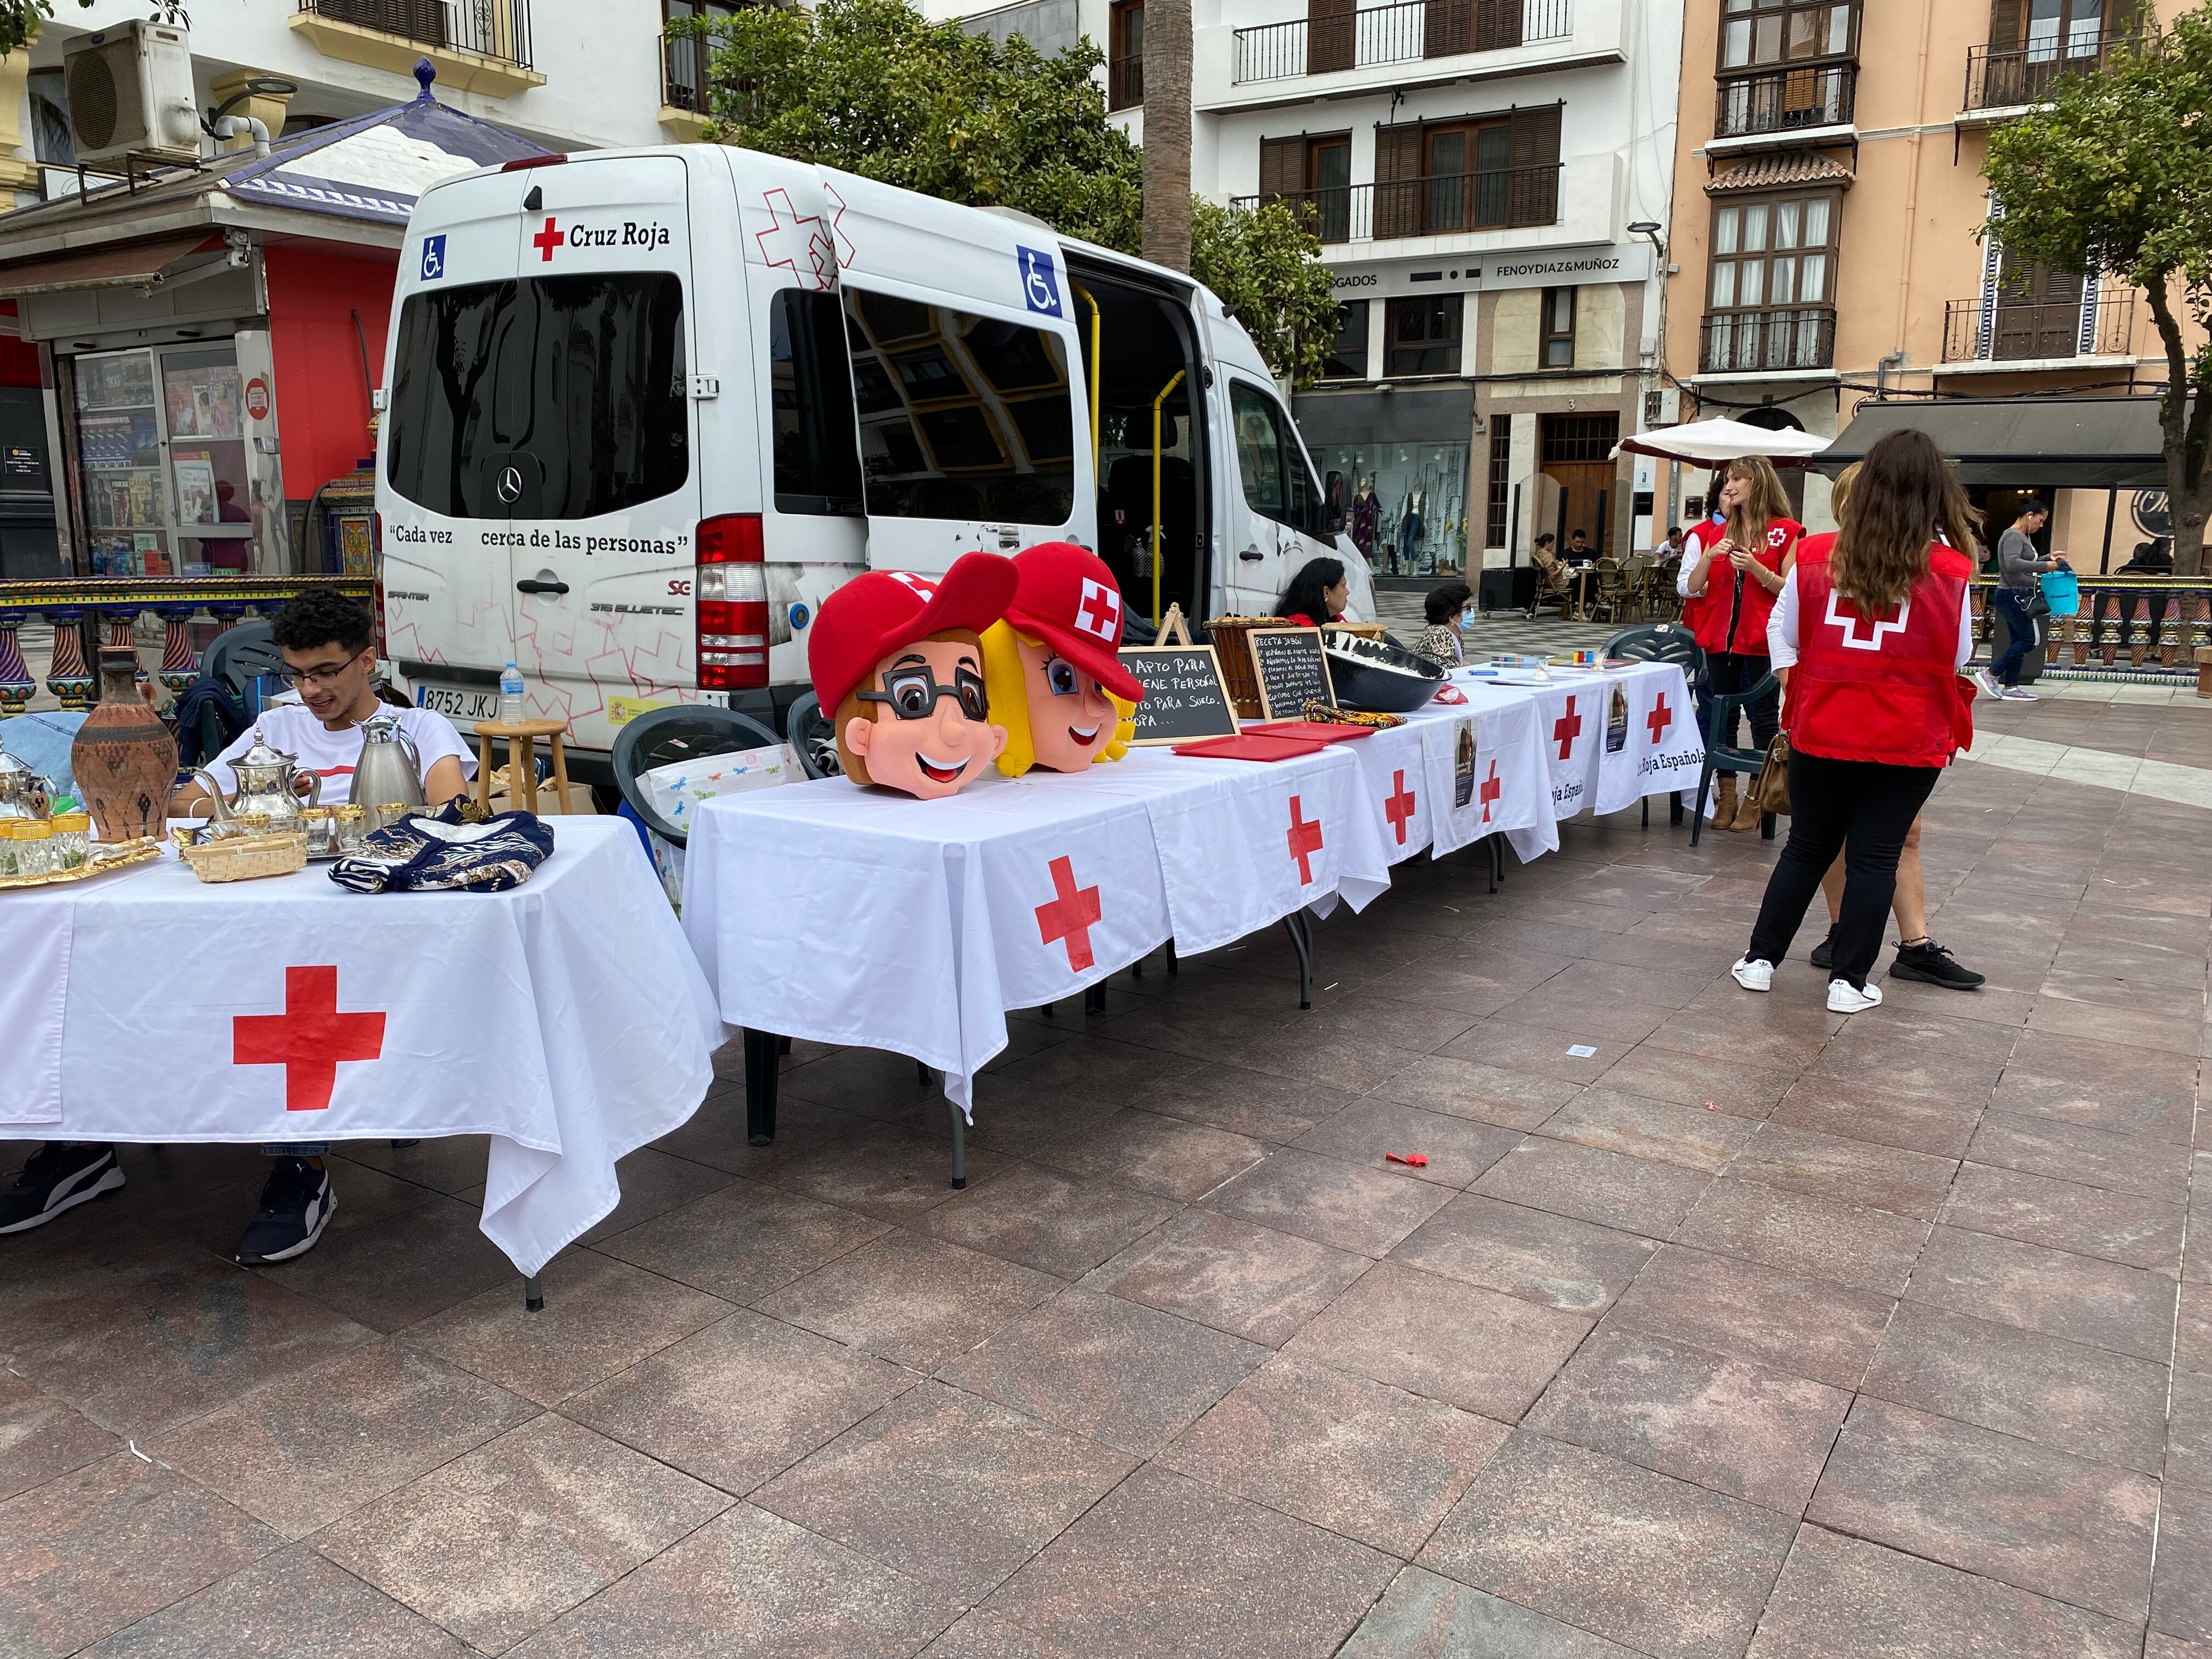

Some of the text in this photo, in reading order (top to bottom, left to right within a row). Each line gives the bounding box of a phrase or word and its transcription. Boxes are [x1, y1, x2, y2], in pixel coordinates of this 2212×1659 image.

[570, 221, 670, 251] Cruz Roja
[1497, 258, 1620, 276] FENOYDIAZ&MUÑOZ
[1568, 399, 1576, 411] 3
[430, 531, 453, 544] vez
[481, 532, 526, 546] cerca
[530, 529, 550, 548] de
[555, 530, 580, 549] las
[590, 603, 685, 616] 316 BLUETEC
[1255, 637, 1282, 647] RECETA
[1136, 659, 1170, 674] APTO
[1173, 658, 1207, 674] PARA
[426, 690, 463, 715] 8752
[467, 695, 498, 719] JKJ
[1154, 696, 1183, 711] PARA
[1659, 749, 1706, 771] Española
